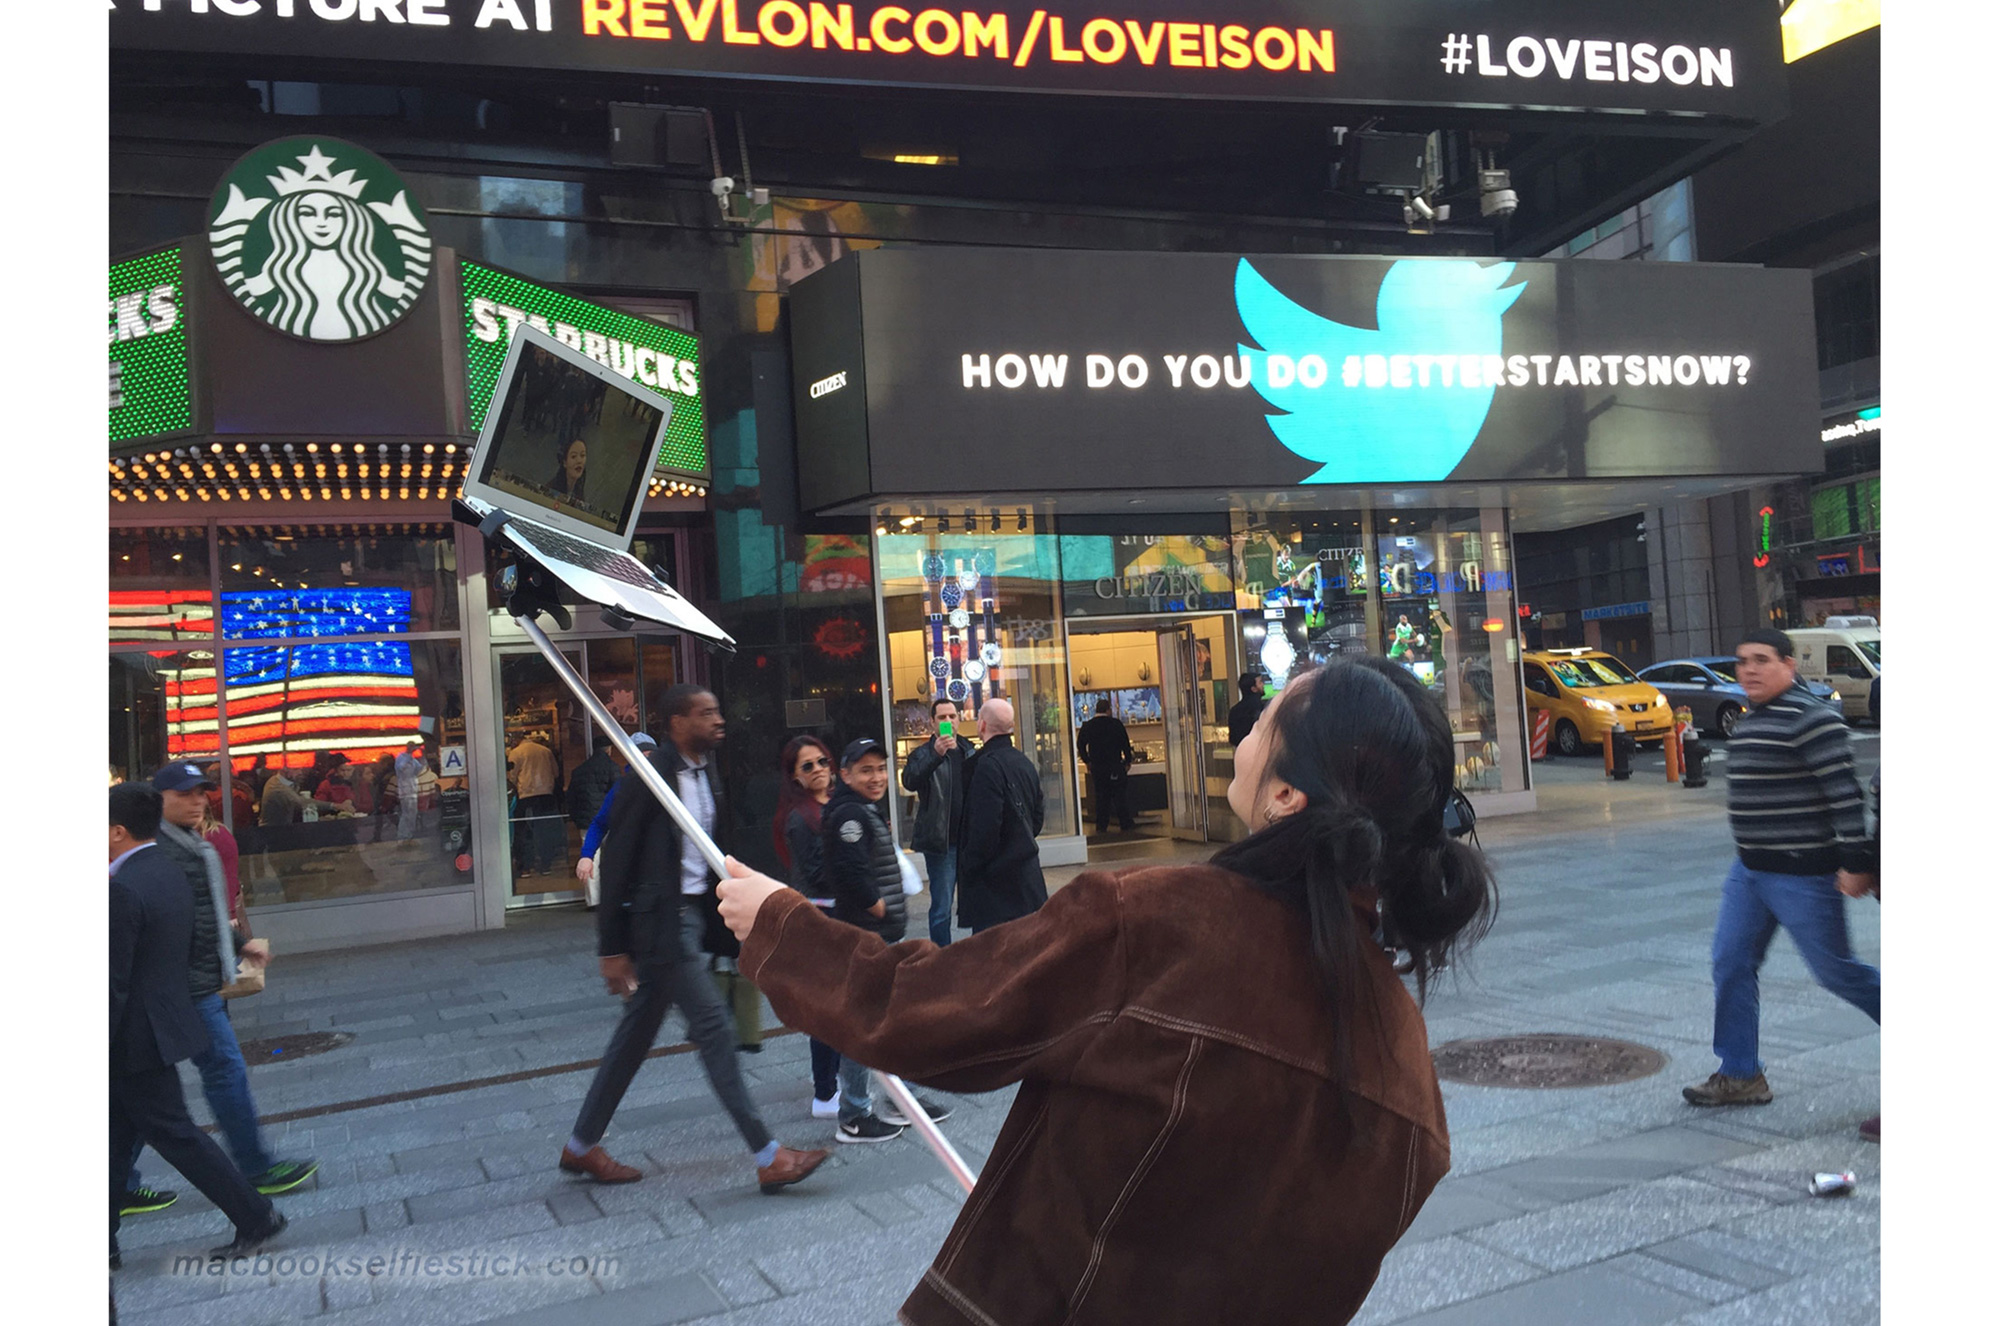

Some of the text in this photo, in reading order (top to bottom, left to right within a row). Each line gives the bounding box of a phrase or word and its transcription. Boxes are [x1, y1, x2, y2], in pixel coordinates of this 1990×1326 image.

[582, 0, 1336, 72] REVLON.COM/LOVEISON
[1440, 33, 1734, 88] #LOVEISON
[109, 284, 178, 344] KS
[810, 371, 847, 399] CITIZEN
[962, 353, 1751, 389] HOW DO YOU DO #BETTERSTARTSNOW?
[1095, 574, 1204, 599] CITIZEN
[446, 750, 462, 768] A
